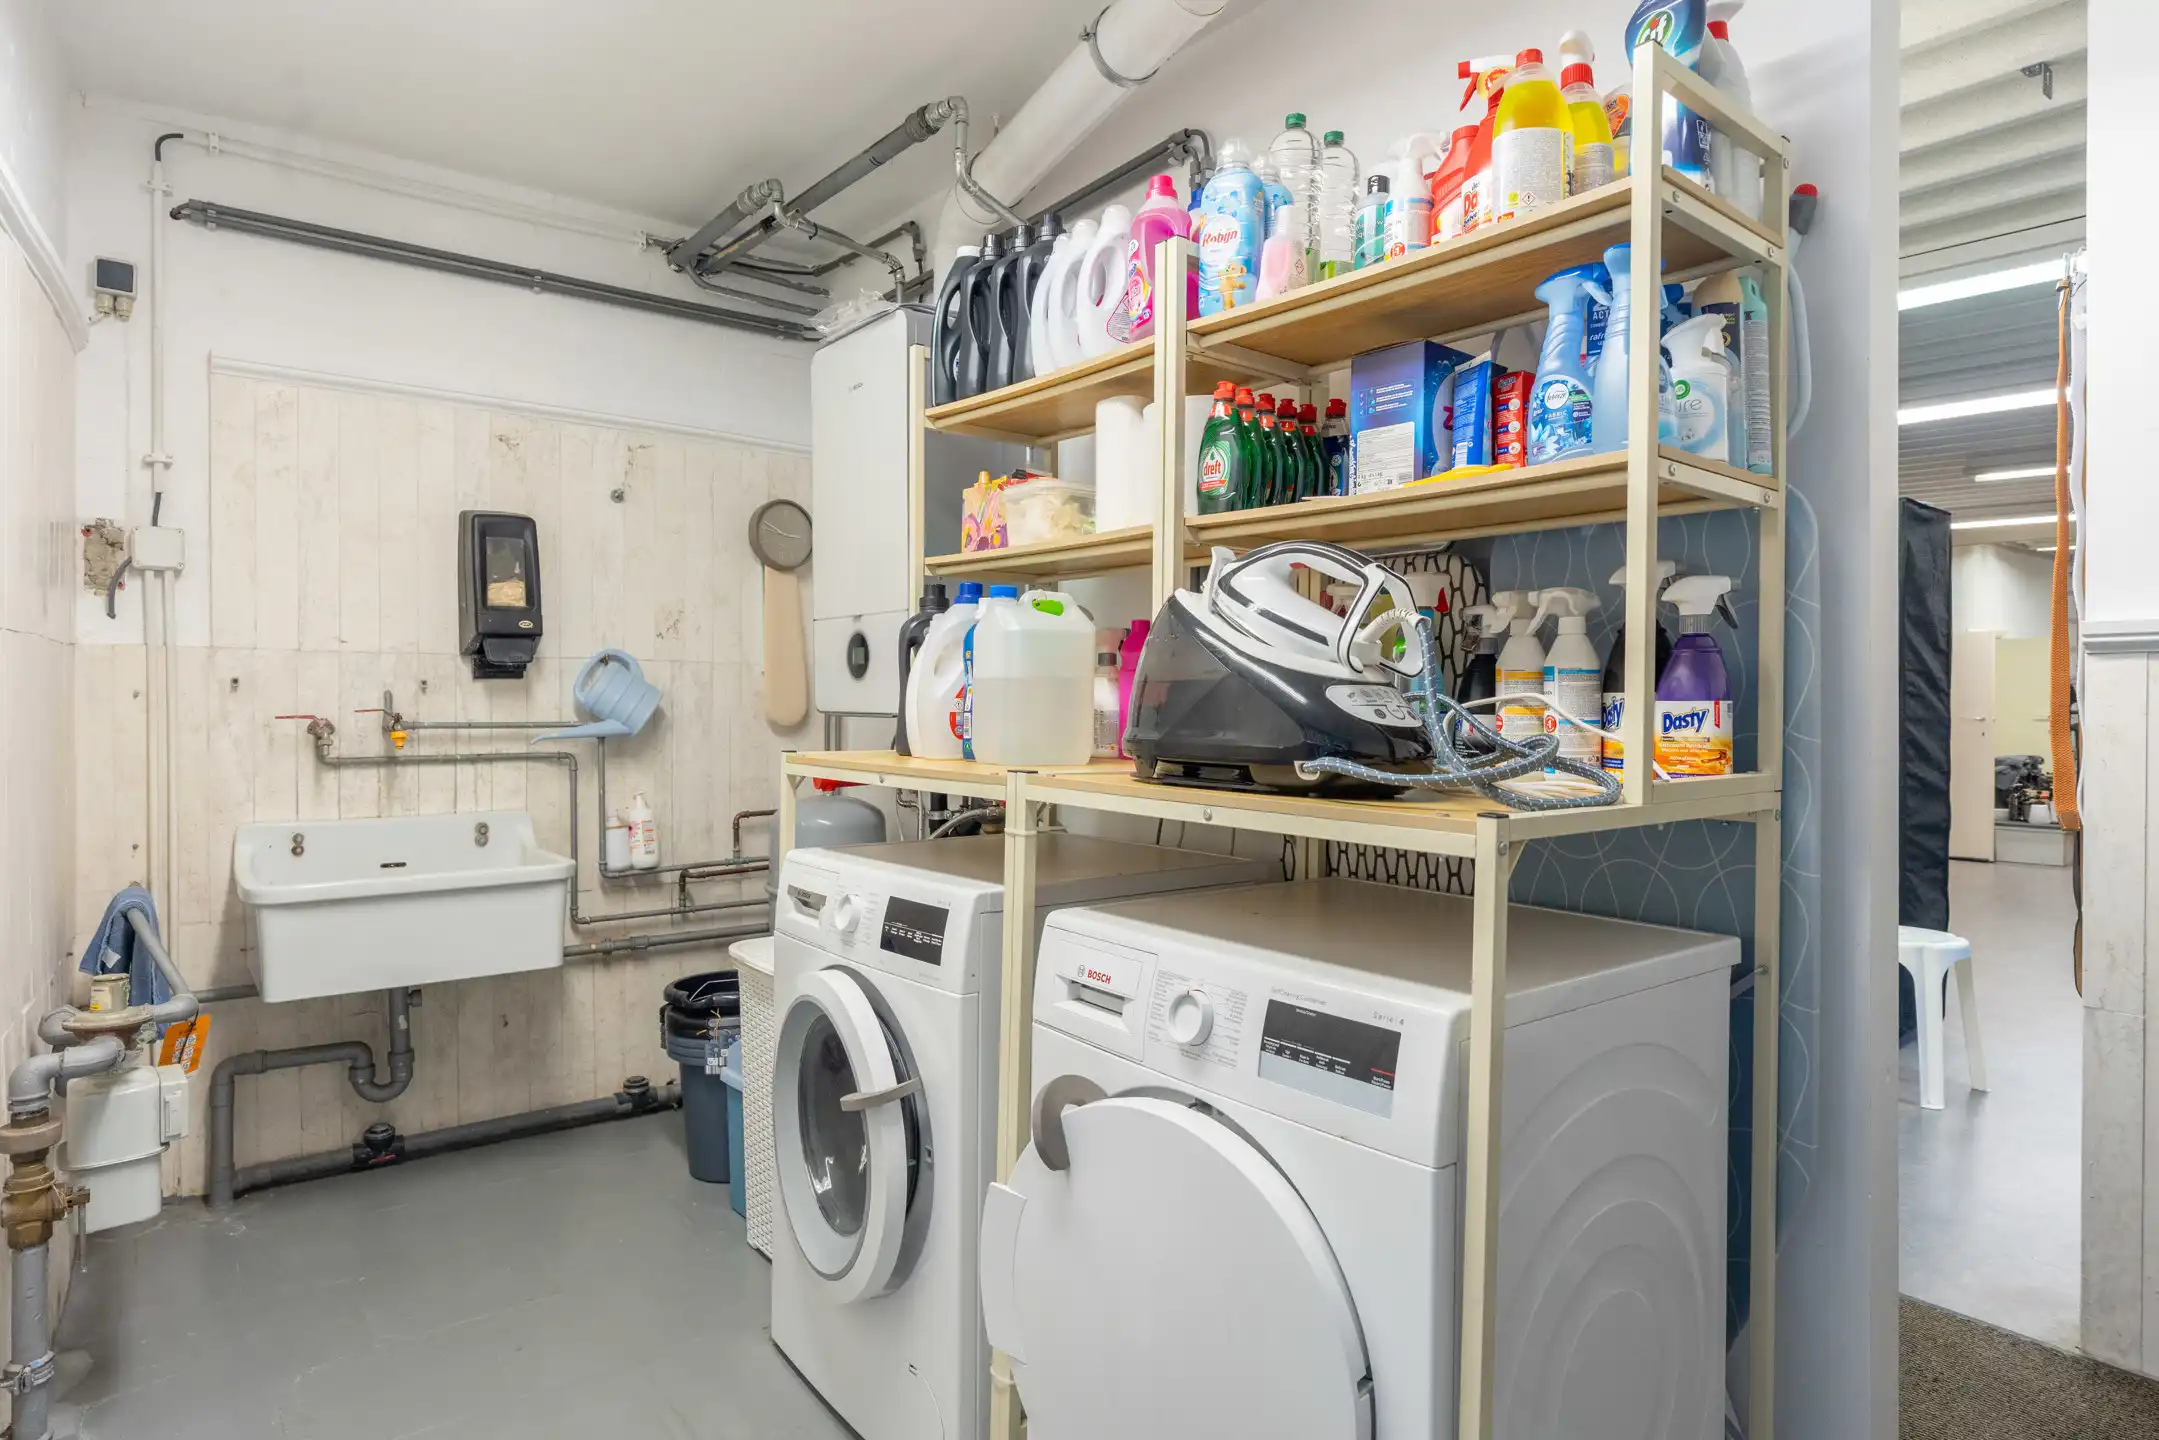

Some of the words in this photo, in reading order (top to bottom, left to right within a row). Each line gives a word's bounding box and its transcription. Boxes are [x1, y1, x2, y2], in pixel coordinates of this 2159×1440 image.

[1592, 310, 1611, 320] ACT
[1590, 332, 1605, 341] rafr
[1675, 398, 1703, 413] ure
[1545, 409, 1568, 420] FABRIC
[1203, 459, 1222, 477] dreft
[1662, 708, 1709, 735] Dasty
[1087, 968, 1112, 985] BOSCH
[1372, 1010, 1394, 1024] Serie
